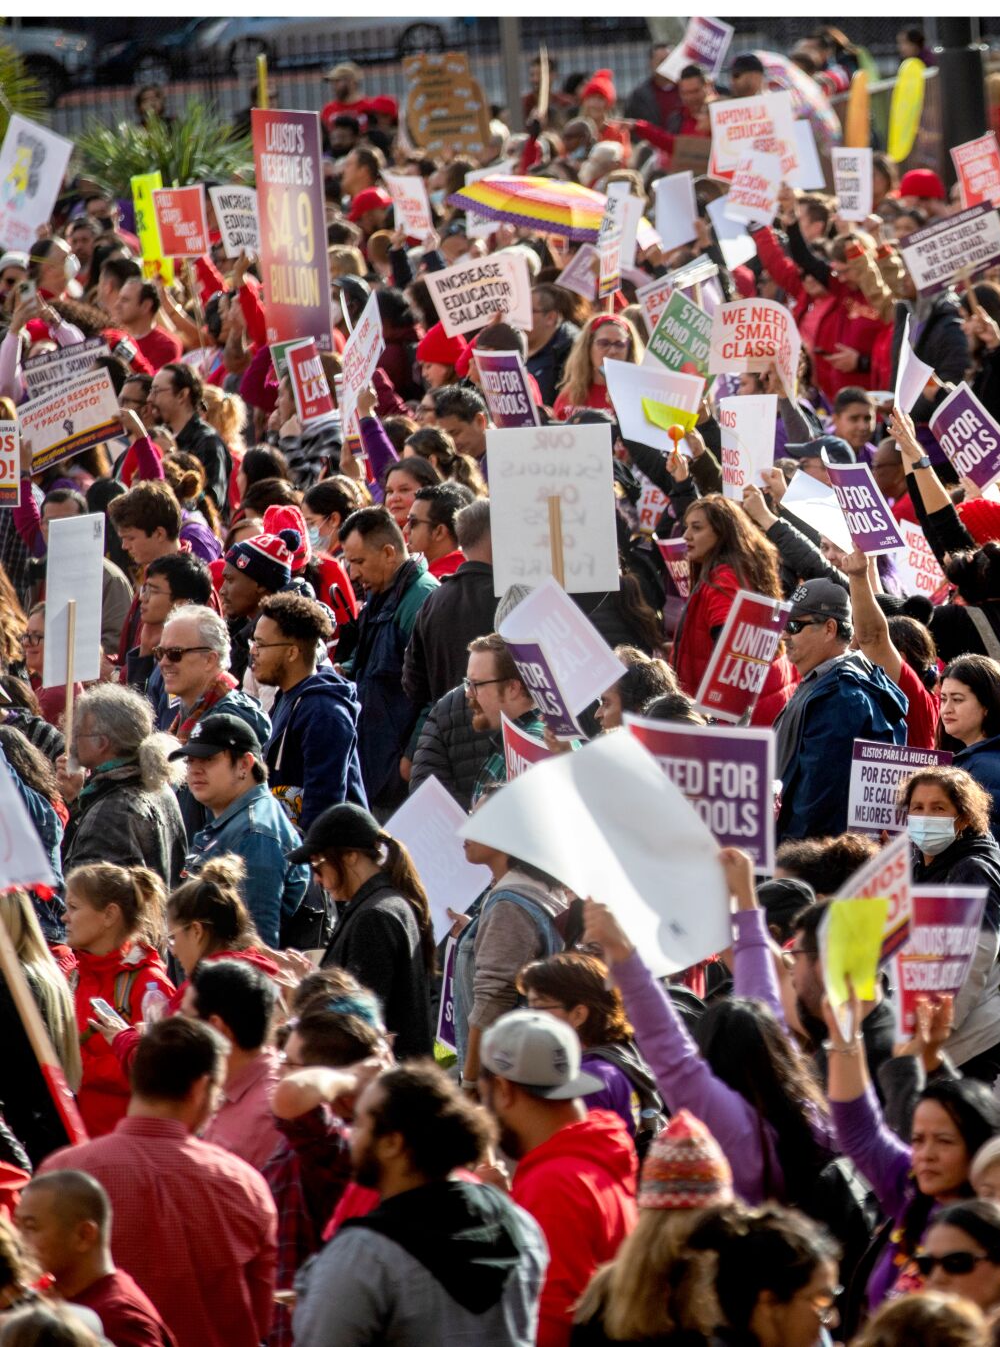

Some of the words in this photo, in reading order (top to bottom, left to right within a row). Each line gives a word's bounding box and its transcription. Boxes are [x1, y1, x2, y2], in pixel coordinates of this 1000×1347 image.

[267, 189, 315, 263] $4.9
[916, 239, 938, 254] POR
[270, 264, 320, 308] BILLION
[435, 262, 503, 294] INCREASE
[442, 281, 511, 311] EDUCATOR
[449, 298, 509, 327] SALARIES
[722, 307, 746, 326] WE
[751, 306, 788, 332] NEED
[662, 316, 689, 344] AND
[735, 324, 785, 346] SMALL
[651, 335, 684, 367] WITH
[722, 340, 776, 359] CLASS
[67, 381, 110, 403] RESPETO
[501, 371, 522, 392] FOR
[34, 422, 39, 431] Y
[41, 411, 66, 428] PAGO
[67, 396, 100, 417] JUSTO!
[949, 408, 984, 441] FOR
[32, 448, 66, 468] education
[722, 469, 745, 486] MNOS
[844, 485, 877, 510] FOR
[900, 750, 908, 762] LA
[909, 752, 938, 766] HUELGA
[707, 762, 757, 800] FOR
[861, 765, 879, 783] POR
[863, 786, 874, 803] DE
[855, 805, 892, 824] MEJORES
